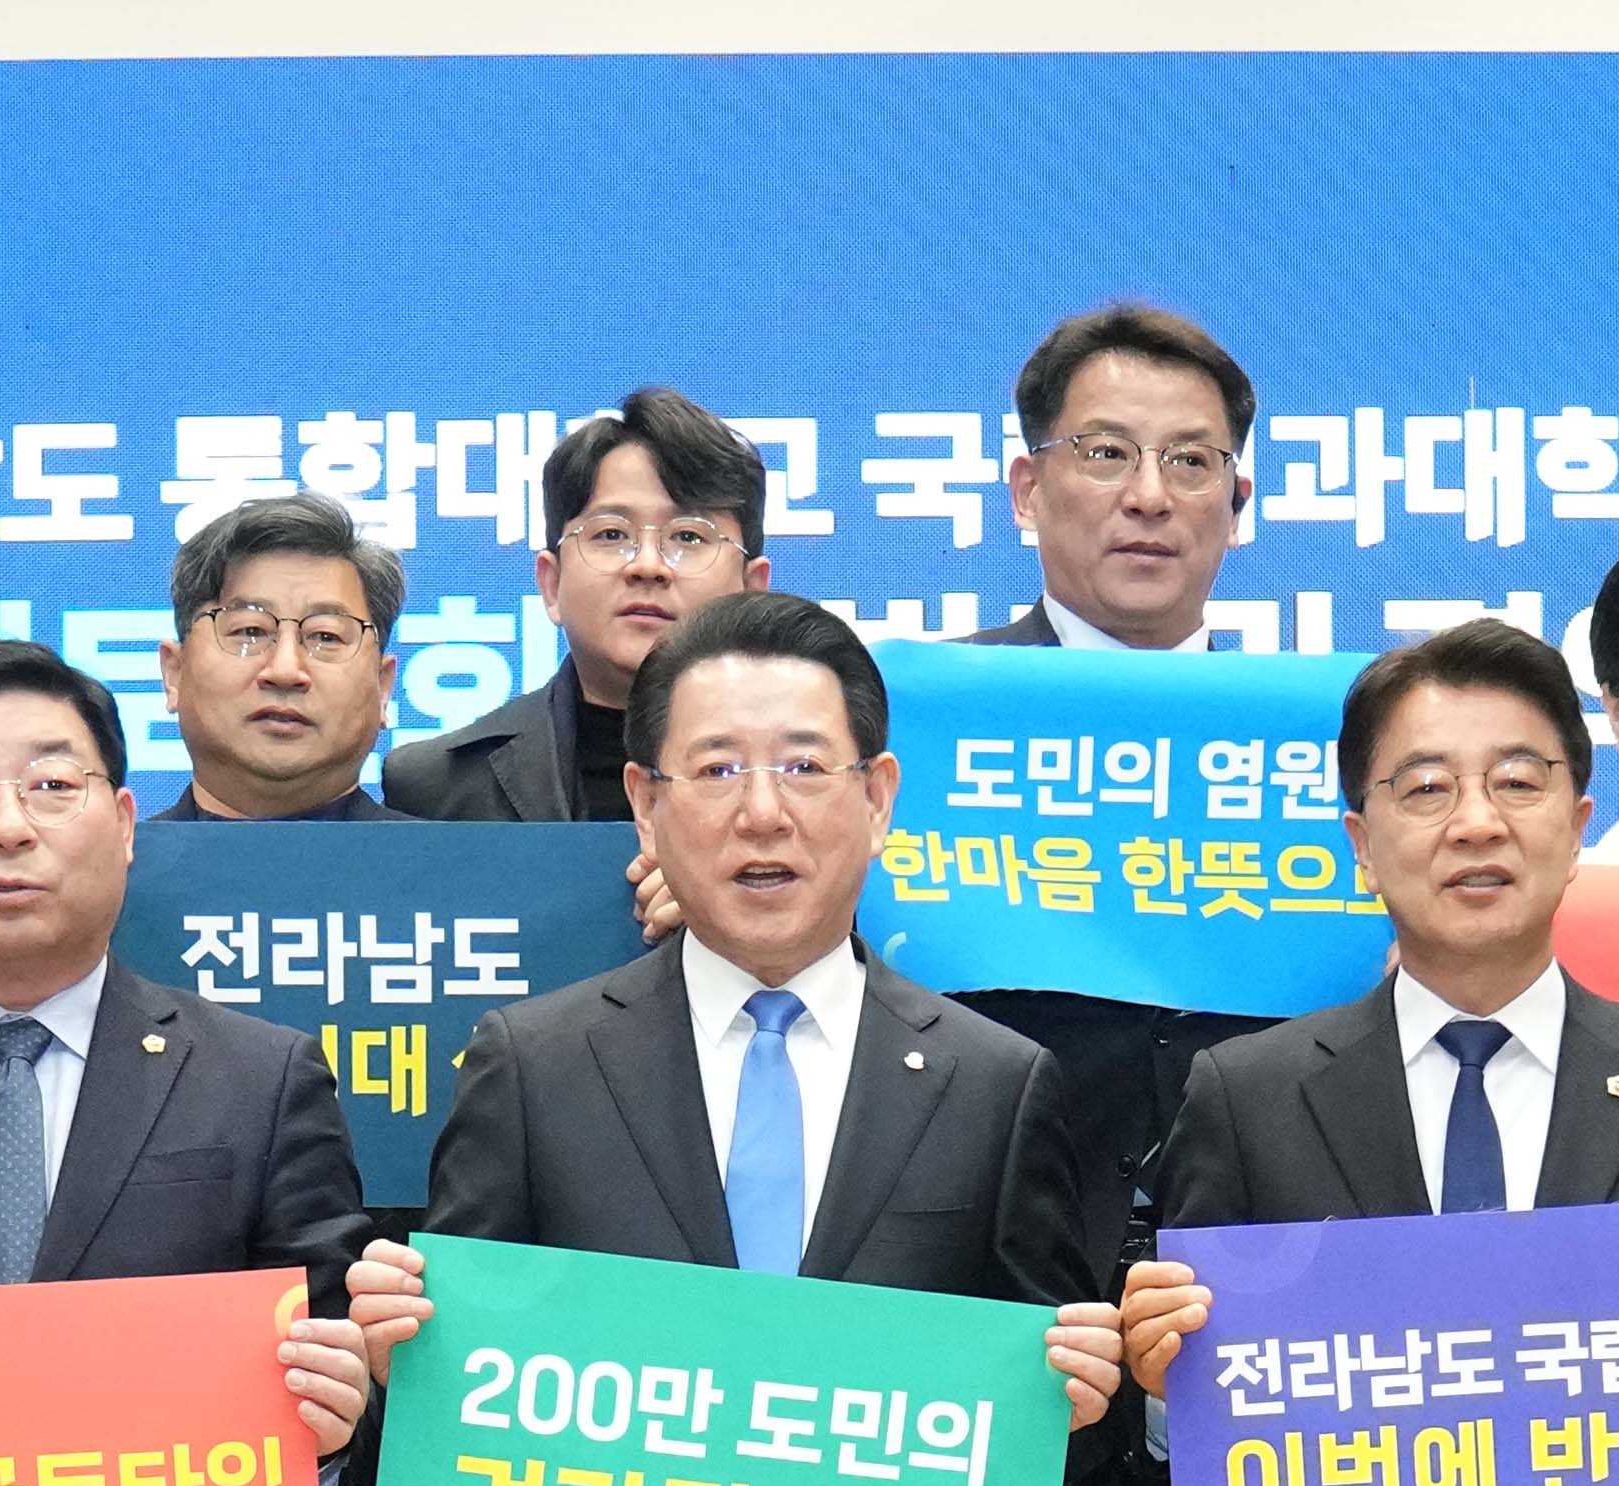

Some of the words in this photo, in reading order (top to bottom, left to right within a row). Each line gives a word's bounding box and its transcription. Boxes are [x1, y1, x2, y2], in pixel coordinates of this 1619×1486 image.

[945, 736, 1172, 820] 도민의
[1197, 738, 1341, 821] 염원
[881, 832, 1101, 914] 한마음
[180, 910, 530, 1006] 전라남도
[459, 1347, 725, 1460] 200만
[1214, 1327, 1506, 1418] 전라남도
